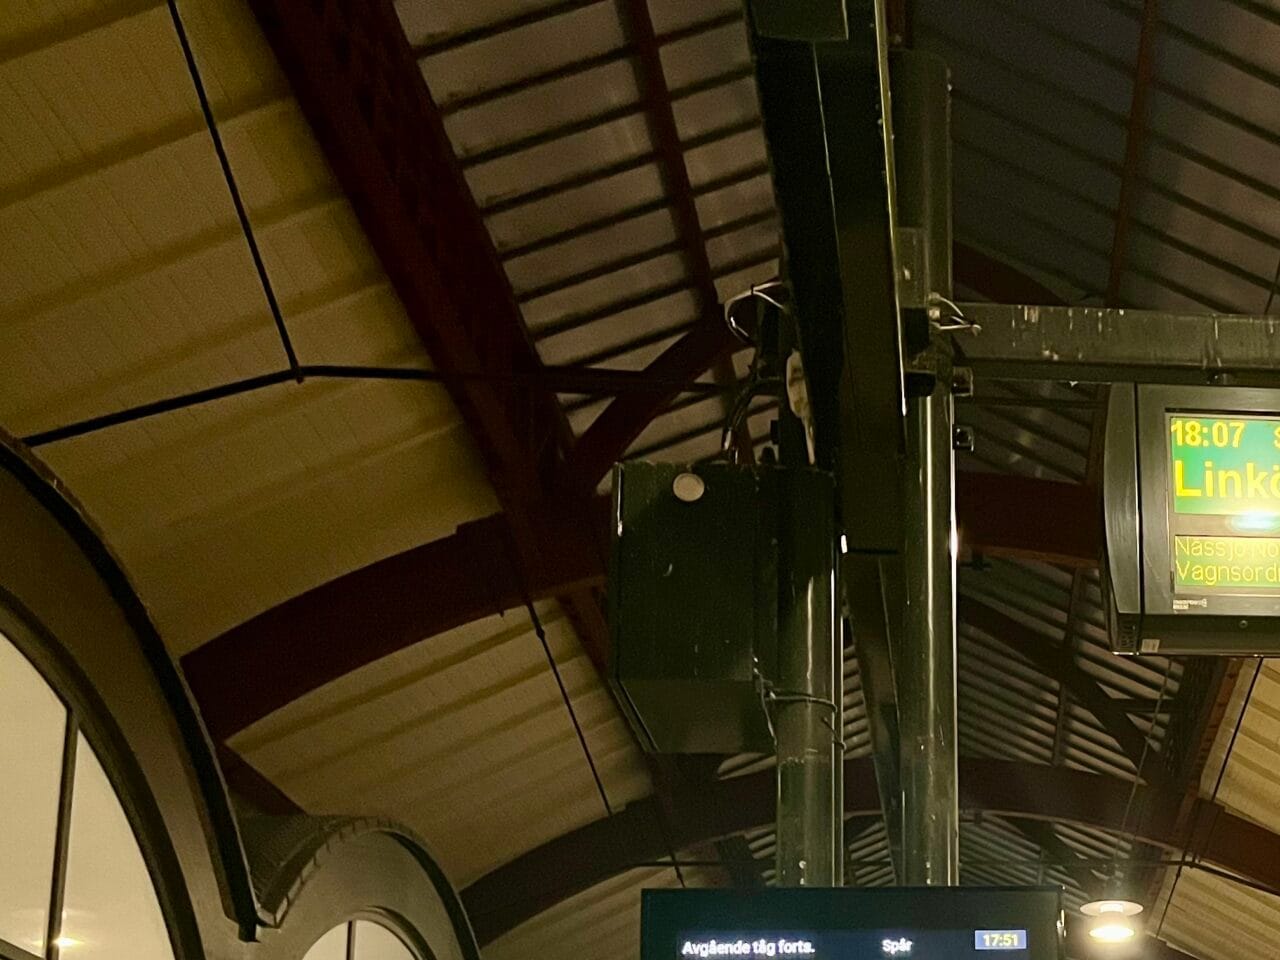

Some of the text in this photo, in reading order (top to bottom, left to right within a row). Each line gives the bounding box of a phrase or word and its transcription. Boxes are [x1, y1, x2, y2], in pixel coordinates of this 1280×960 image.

[1170, 420, 1245, 448] 18:07
[682, 934, 1018, 957] Avgående tåg forts. Spår 17:51
